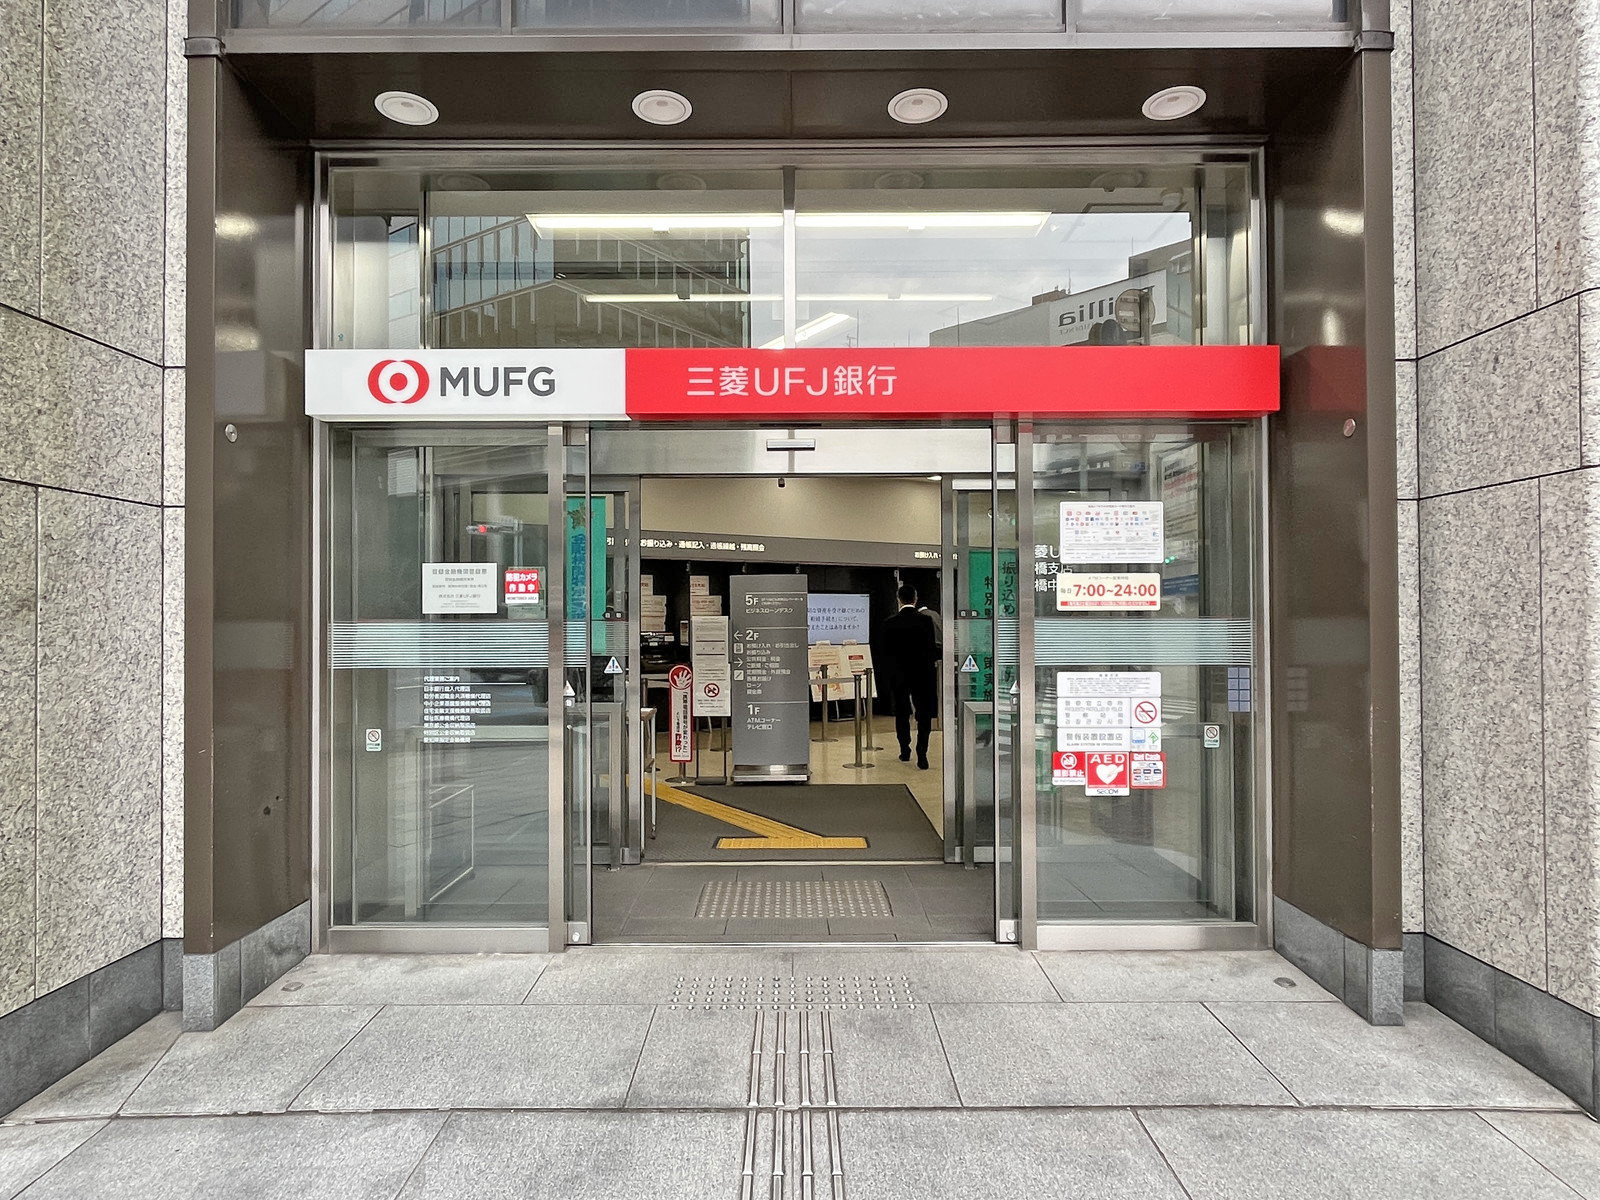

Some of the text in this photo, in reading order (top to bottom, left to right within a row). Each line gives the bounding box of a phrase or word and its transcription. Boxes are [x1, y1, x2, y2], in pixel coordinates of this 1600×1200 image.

[440, 366, 556, 397] MUFG
[687, 365, 898, 396] 三菱UFJ銀行
[505, 573, 538, 582] 防犯カメラ
[1073, 584, 1157, 597] 7:00~24:00
[745, 594, 759, 606] 5F
[745, 629, 760, 641] 2F
[747, 704, 761, 715] 1F
[1090, 754, 1125, 764] AED
